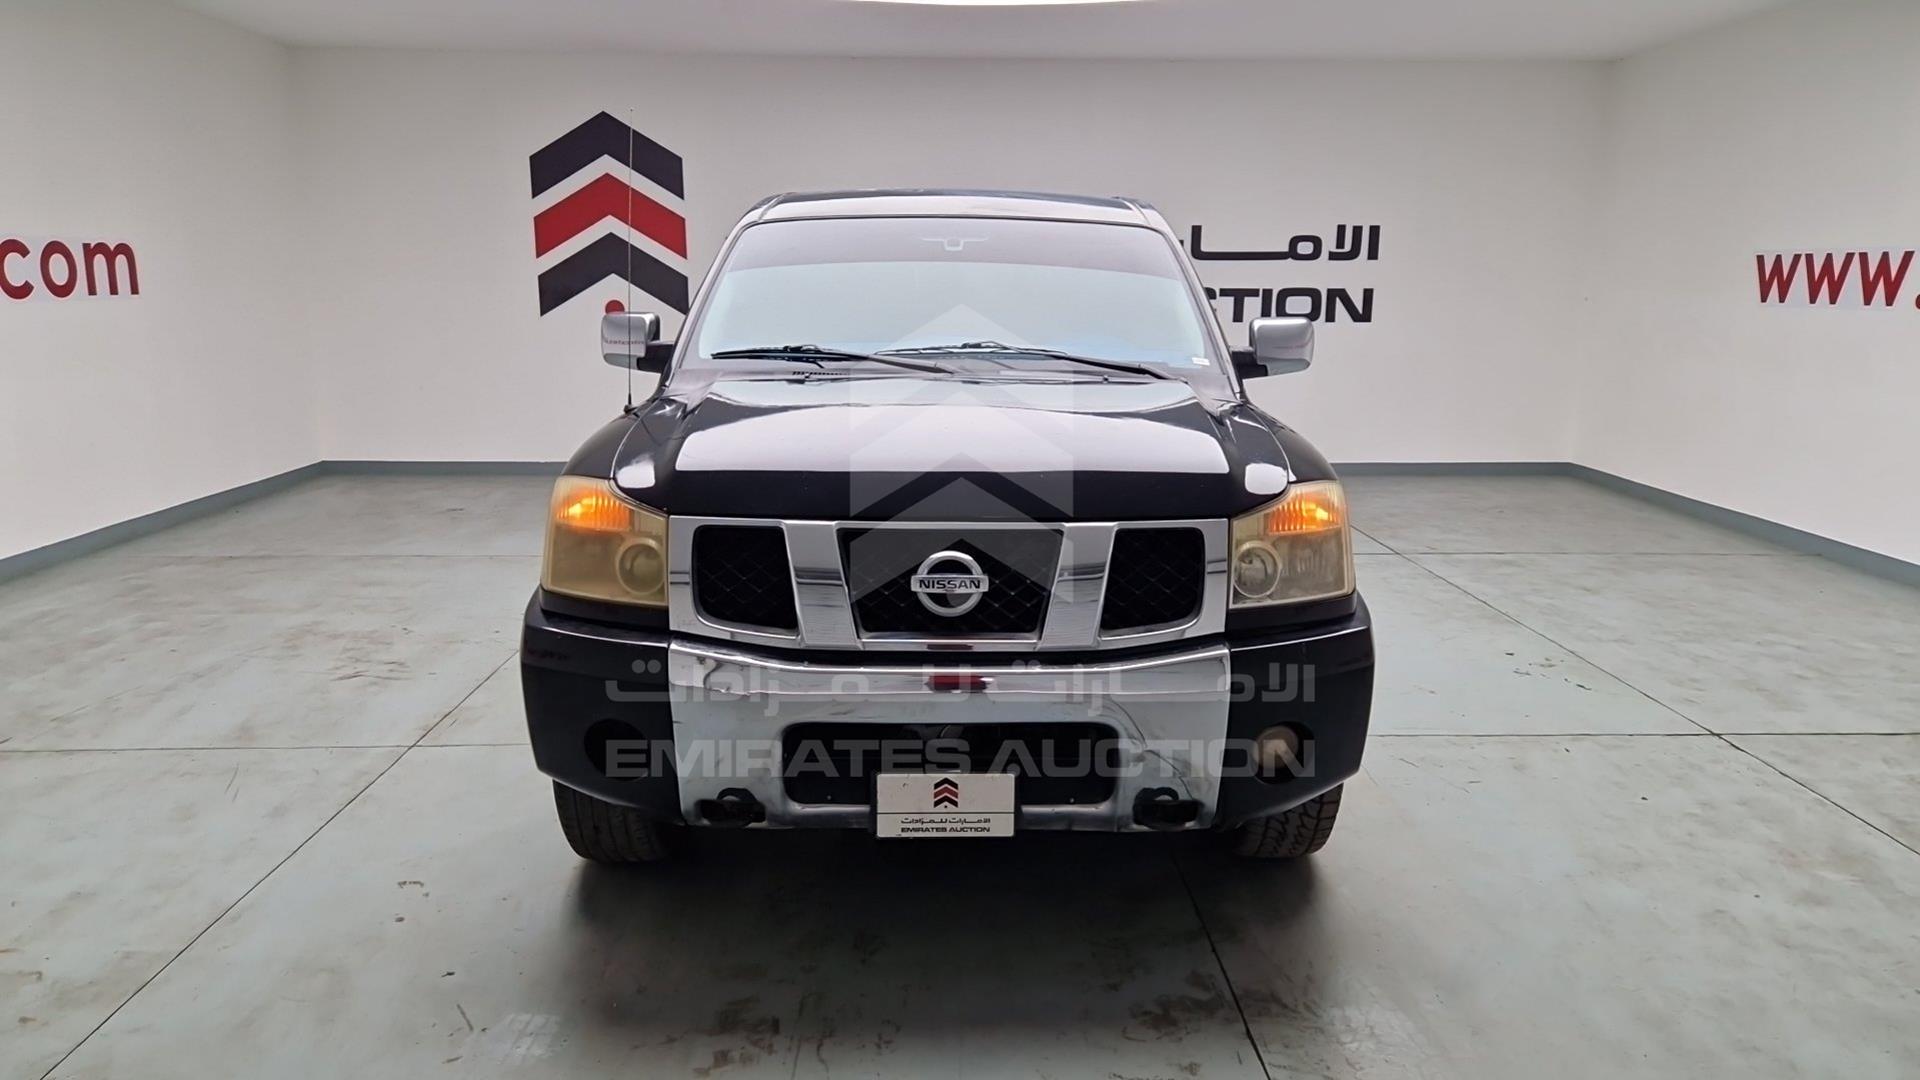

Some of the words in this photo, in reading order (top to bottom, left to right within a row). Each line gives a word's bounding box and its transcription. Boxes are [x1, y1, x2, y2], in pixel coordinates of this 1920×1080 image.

[1180, 224, 1380, 260] الاما
[0, 238, 140, 300] com
[918, 579, 981, 590] NISSAN
